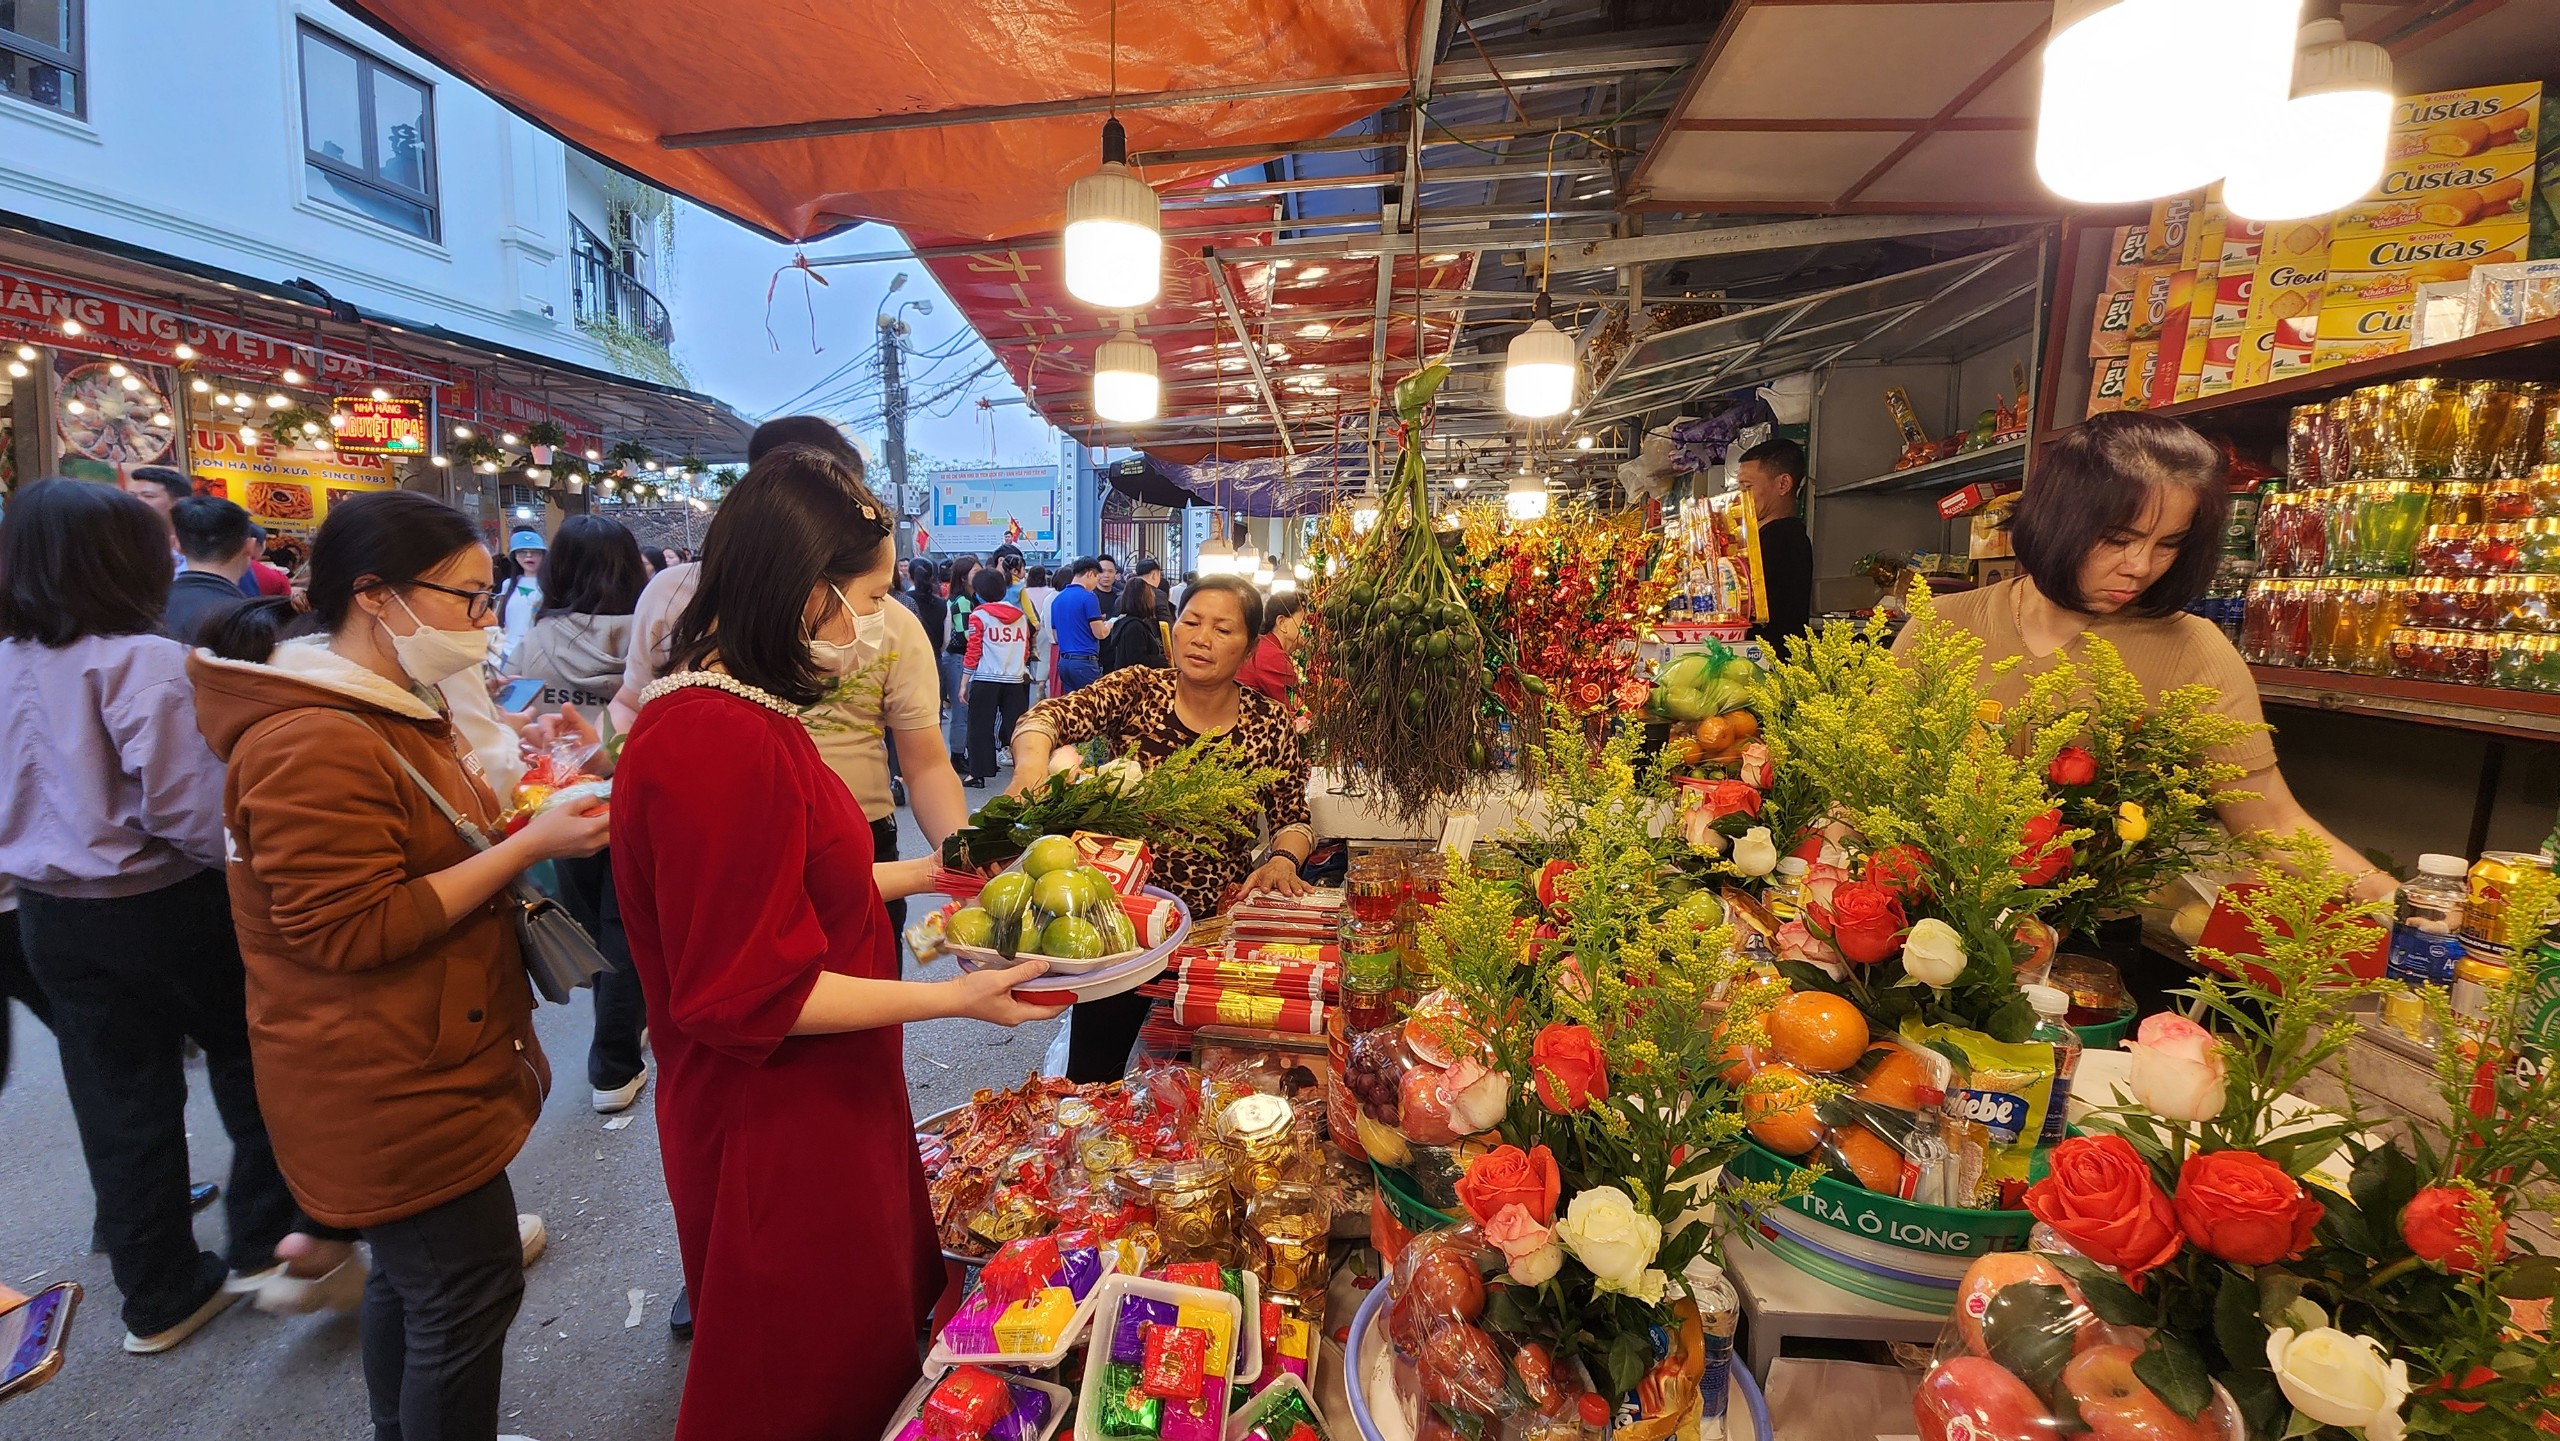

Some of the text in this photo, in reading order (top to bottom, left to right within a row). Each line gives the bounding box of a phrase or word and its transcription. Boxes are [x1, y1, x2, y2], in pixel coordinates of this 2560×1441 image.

[2394, 97, 2502, 126] Custas
[2380, 166, 2496, 195] Custas
[2418, 232, 2454, 241] ORION
[2369, 238, 2488, 266] Custas
[0, 279, 104, 326] ÀNG
[292, 345, 364, 377] NGA
[196, 430, 278, 462] UYỆ
[229, 460, 248, 471] HÀ
[253, 462, 277, 474] NỘI
[283, 466, 309, 475] XƯA
[322, 470, 356, 480] SINCE
[360, 475, 386, 483] 1983
[988, 626, 1026, 643] U.S.A
[1801, 1193, 1851, 1227] TRÀ
[1857, 1209, 1883, 1234] Ô
[1890, 1221, 1971, 1251] LONG
